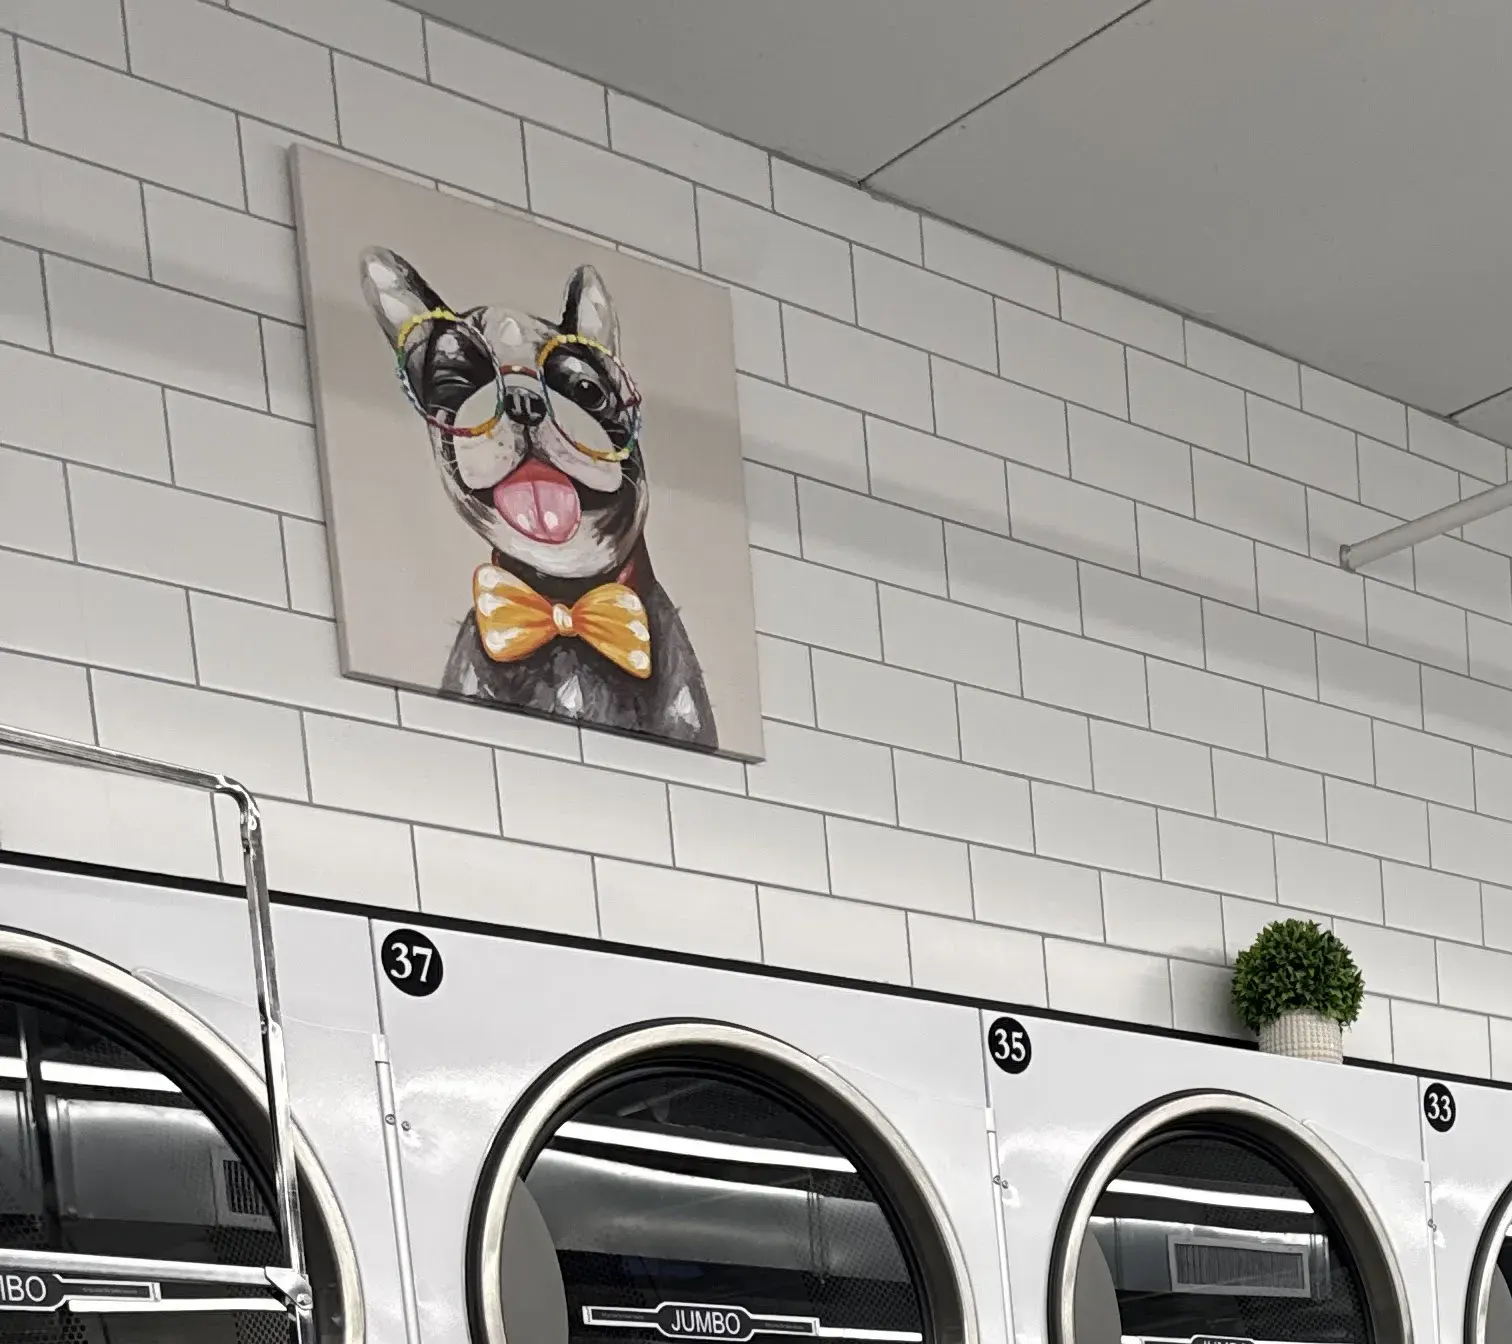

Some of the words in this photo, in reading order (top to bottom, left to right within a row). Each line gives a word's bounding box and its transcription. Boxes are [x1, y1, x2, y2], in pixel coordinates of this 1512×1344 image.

[391, 943, 432, 982] 37
[994, 1028, 1026, 1061] 35
[1428, 1092, 1452, 1121] 33
[671, 1309, 740, 1335] JUMBO
